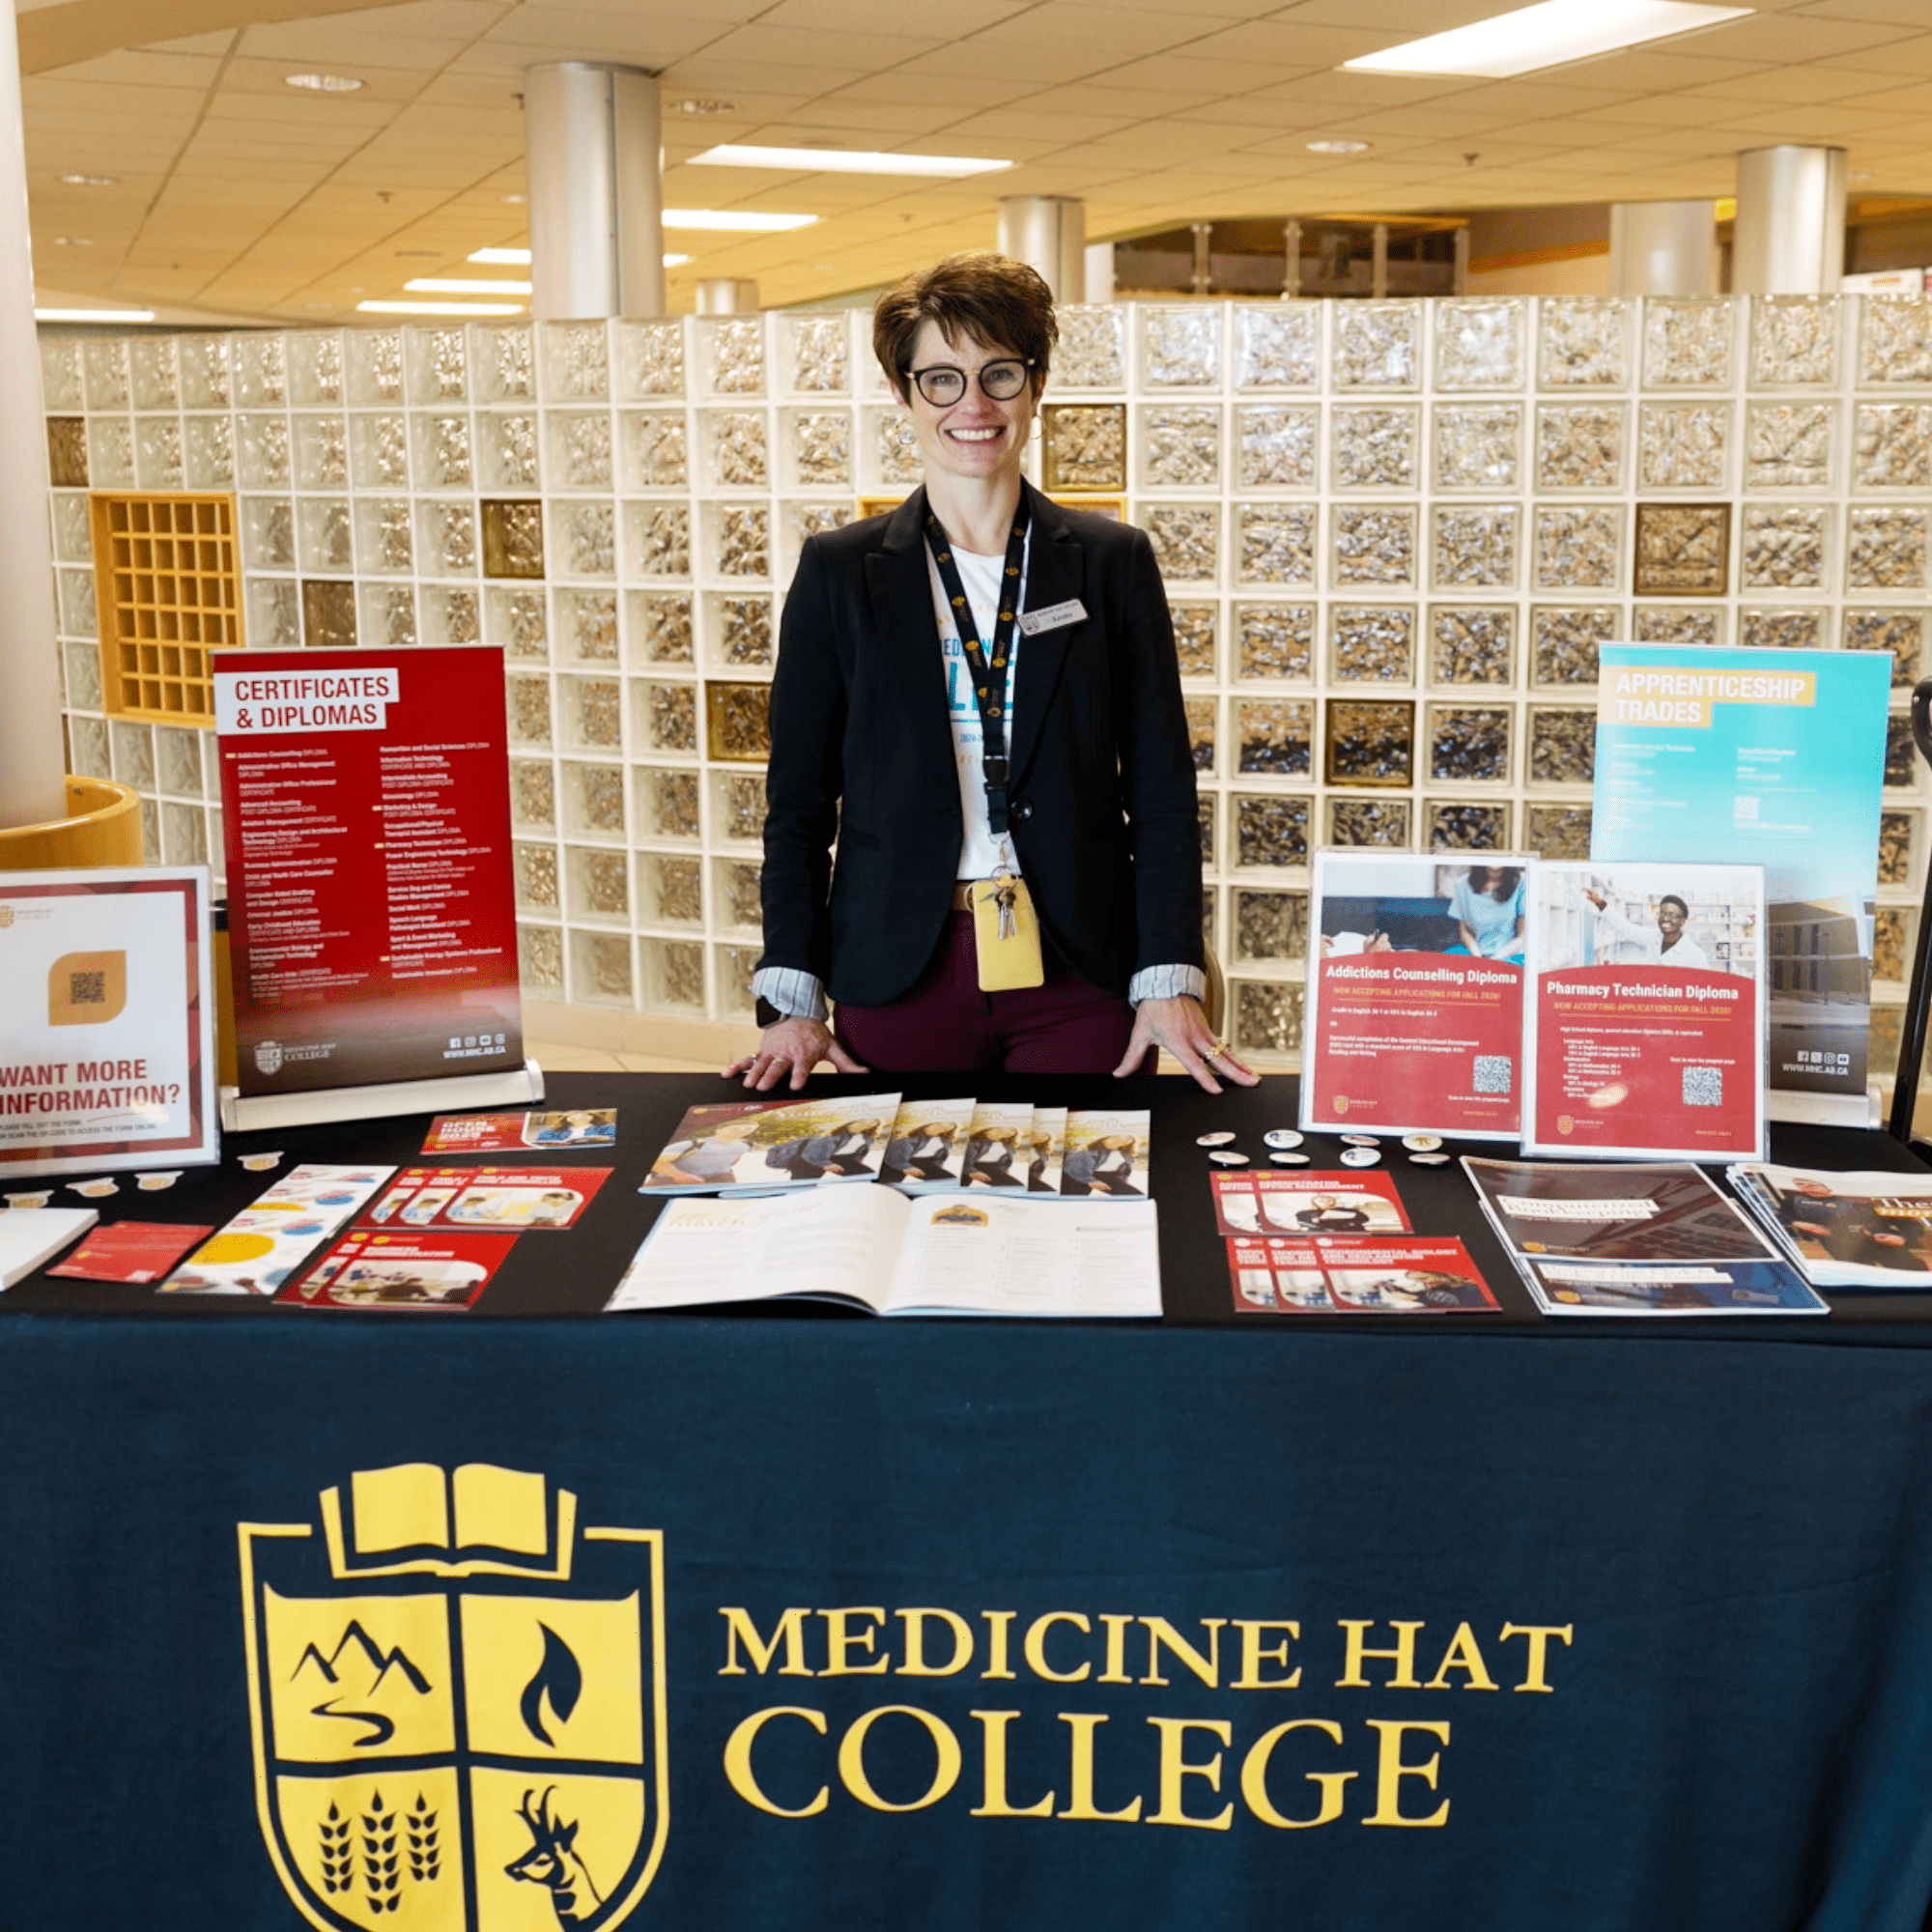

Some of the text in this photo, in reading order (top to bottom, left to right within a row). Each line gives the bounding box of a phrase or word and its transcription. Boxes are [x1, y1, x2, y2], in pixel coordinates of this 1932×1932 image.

[236, 677, 389, 700] CERTIFICATES
[1616, 673, 1805, 699] APPRENTICESHIP
[237, 703, 377, 728] & DIPLOMAS
[1616, 700, 1701, 723] TRADES
[1327, 965, 1517, 985] Addictions Counselling Diploma
[1547, 981, 1739, 1002] Pharmacy Technician Diploma
[285, 1050, 329, 1061] COLLEGE
[0, 1059, 147, 1087] WANT MORE
[0, 1084, 180, 1115] INFORMATION?
[719, 1607, 1572, 1692] MEDICINE HAT
[724, 1706, 1450, 1830] COLLEGE
